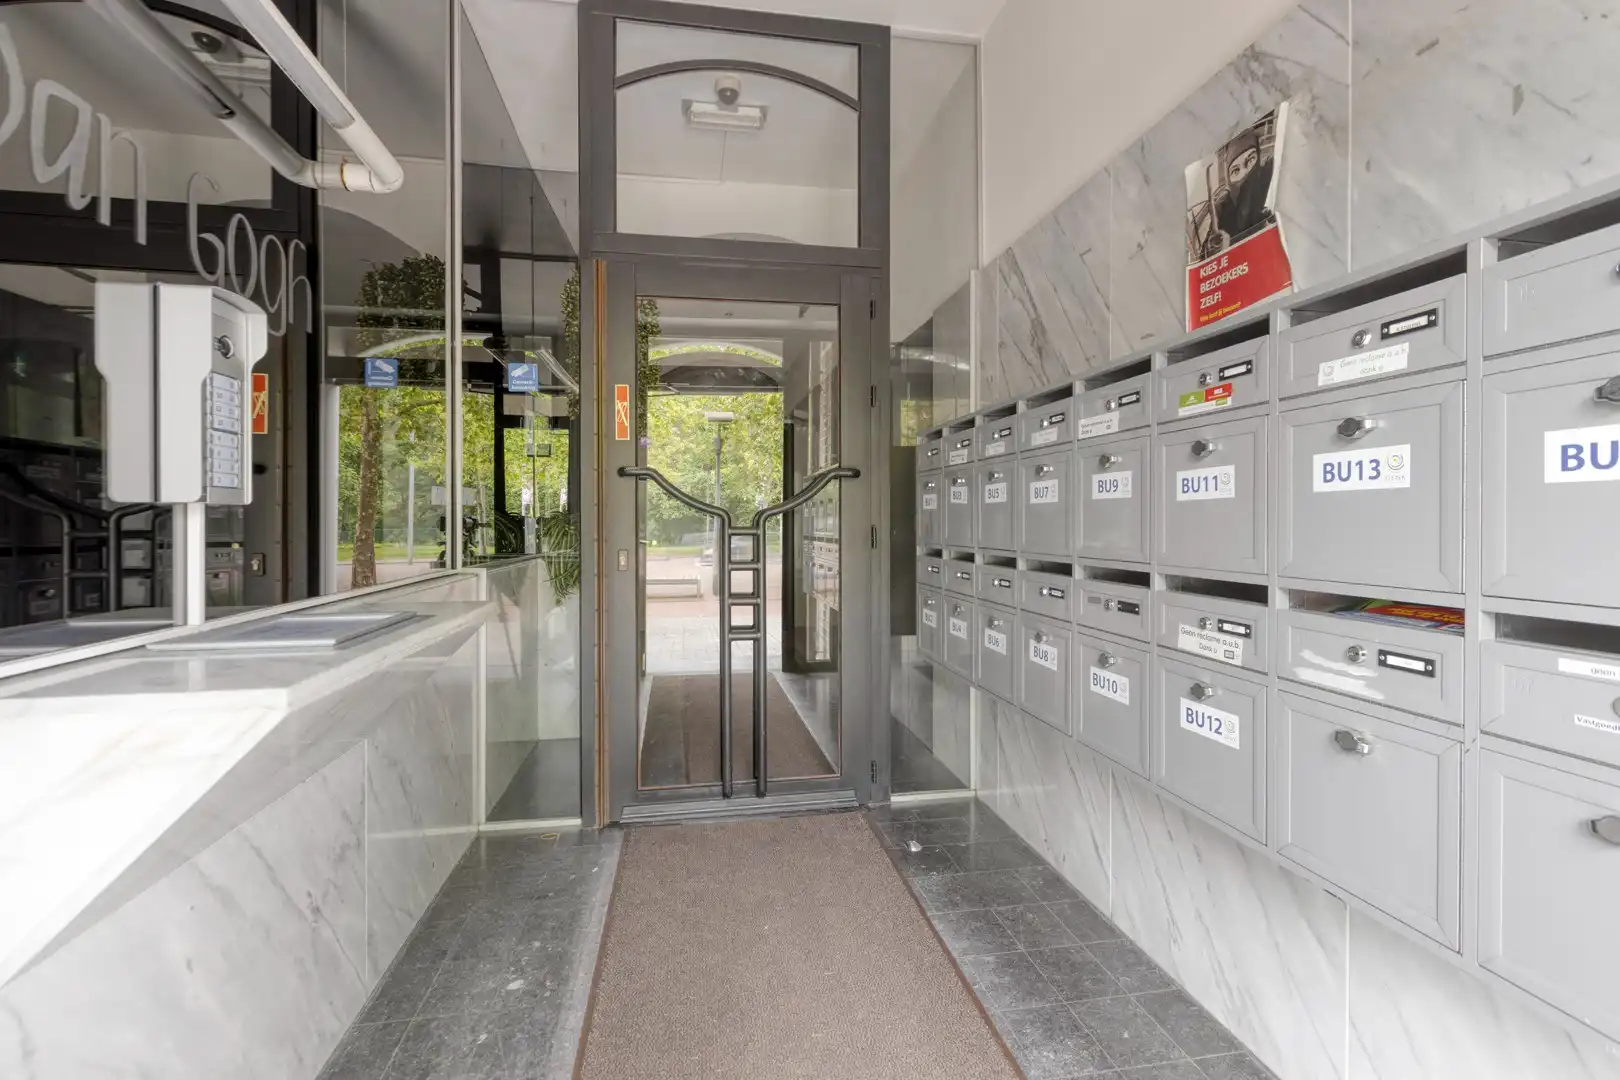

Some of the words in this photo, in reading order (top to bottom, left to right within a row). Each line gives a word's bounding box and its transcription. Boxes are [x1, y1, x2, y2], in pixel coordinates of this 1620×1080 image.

[1200, 261, 1217, 278] KIES
[1219, 255, 1229, 269] JE
[1200, 261, 1249, 293] BEZOEKERS
[1200, 291, 1222, 309] ZELF!
[1560, 439, 1619, 472] BU
[1322, 458, 1381, 483] BU13
[987, 488, 1000, 499] BU5
[1034, 486, 1049, 499] BU7
[1097, 479, 1119, 493] BU9
[1181, 475, 1219, 494] BU11
[987, 634, 1000, 648] BU6
[1033, 645, 1049, 662] BU8
[1092, 672, 1118, 694] BU10
[1185, 707, 1223, 735] BU12
